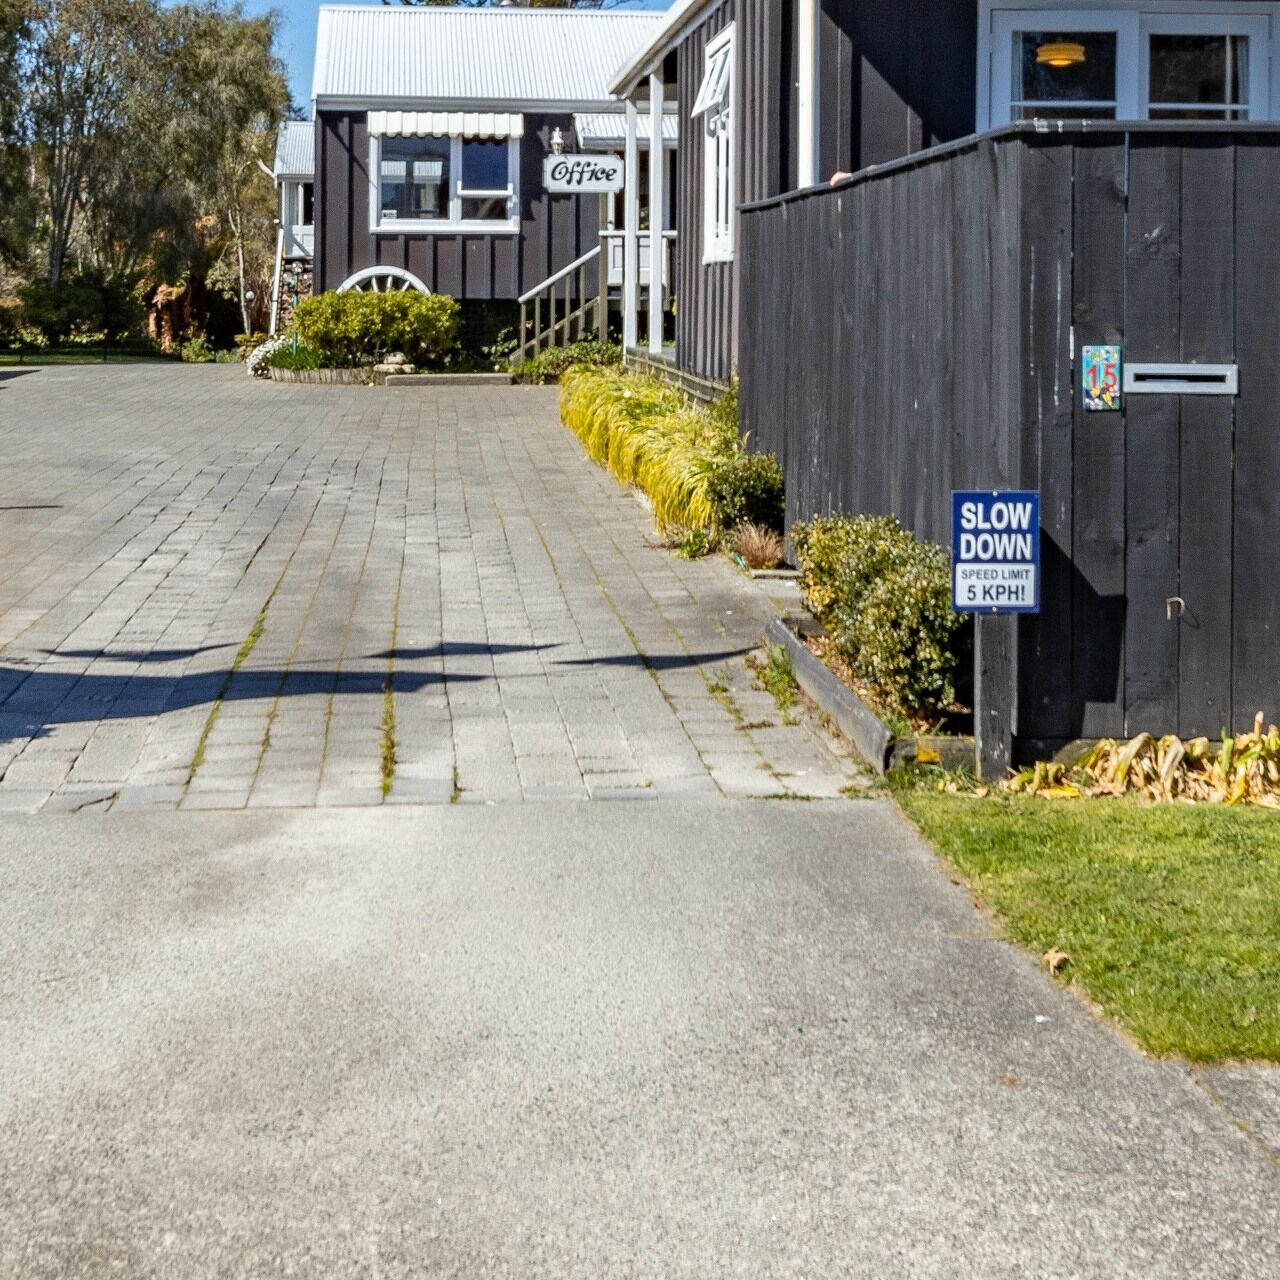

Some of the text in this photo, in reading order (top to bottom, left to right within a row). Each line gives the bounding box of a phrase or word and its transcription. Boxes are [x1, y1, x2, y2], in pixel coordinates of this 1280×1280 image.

[551, 161, 618, 185] Office
[1088, 363, 1117, 389] 15
[961, 502, 1032, 530] SLOW
[960, 533, 1032, 560] DOWN
[961, 569, 1030, 580] SPEED LIMIT
[967, 585, 1025, 601] 5 KPH!
